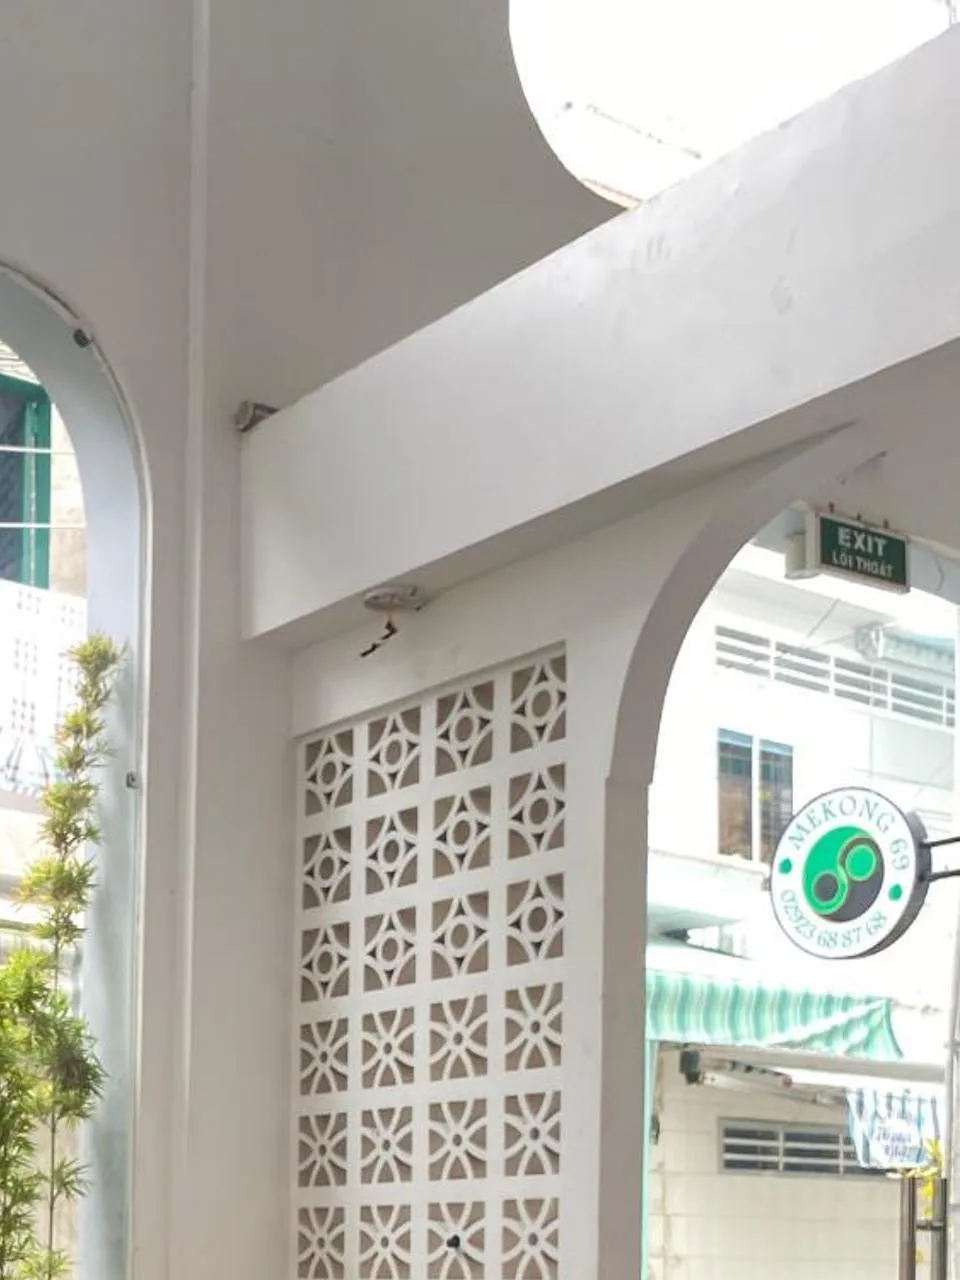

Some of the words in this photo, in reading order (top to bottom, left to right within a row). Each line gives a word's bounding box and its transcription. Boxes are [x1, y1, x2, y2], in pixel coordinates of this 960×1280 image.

[837, 526, 888, 557] EXIT
[788, 795, 896, 851] MEKONG
[889, 838, 910, 871] 69
[816, 927, 839, 949] 68
[841, 925, 863, 949] 87
[865, 910, 888, 936] 68
